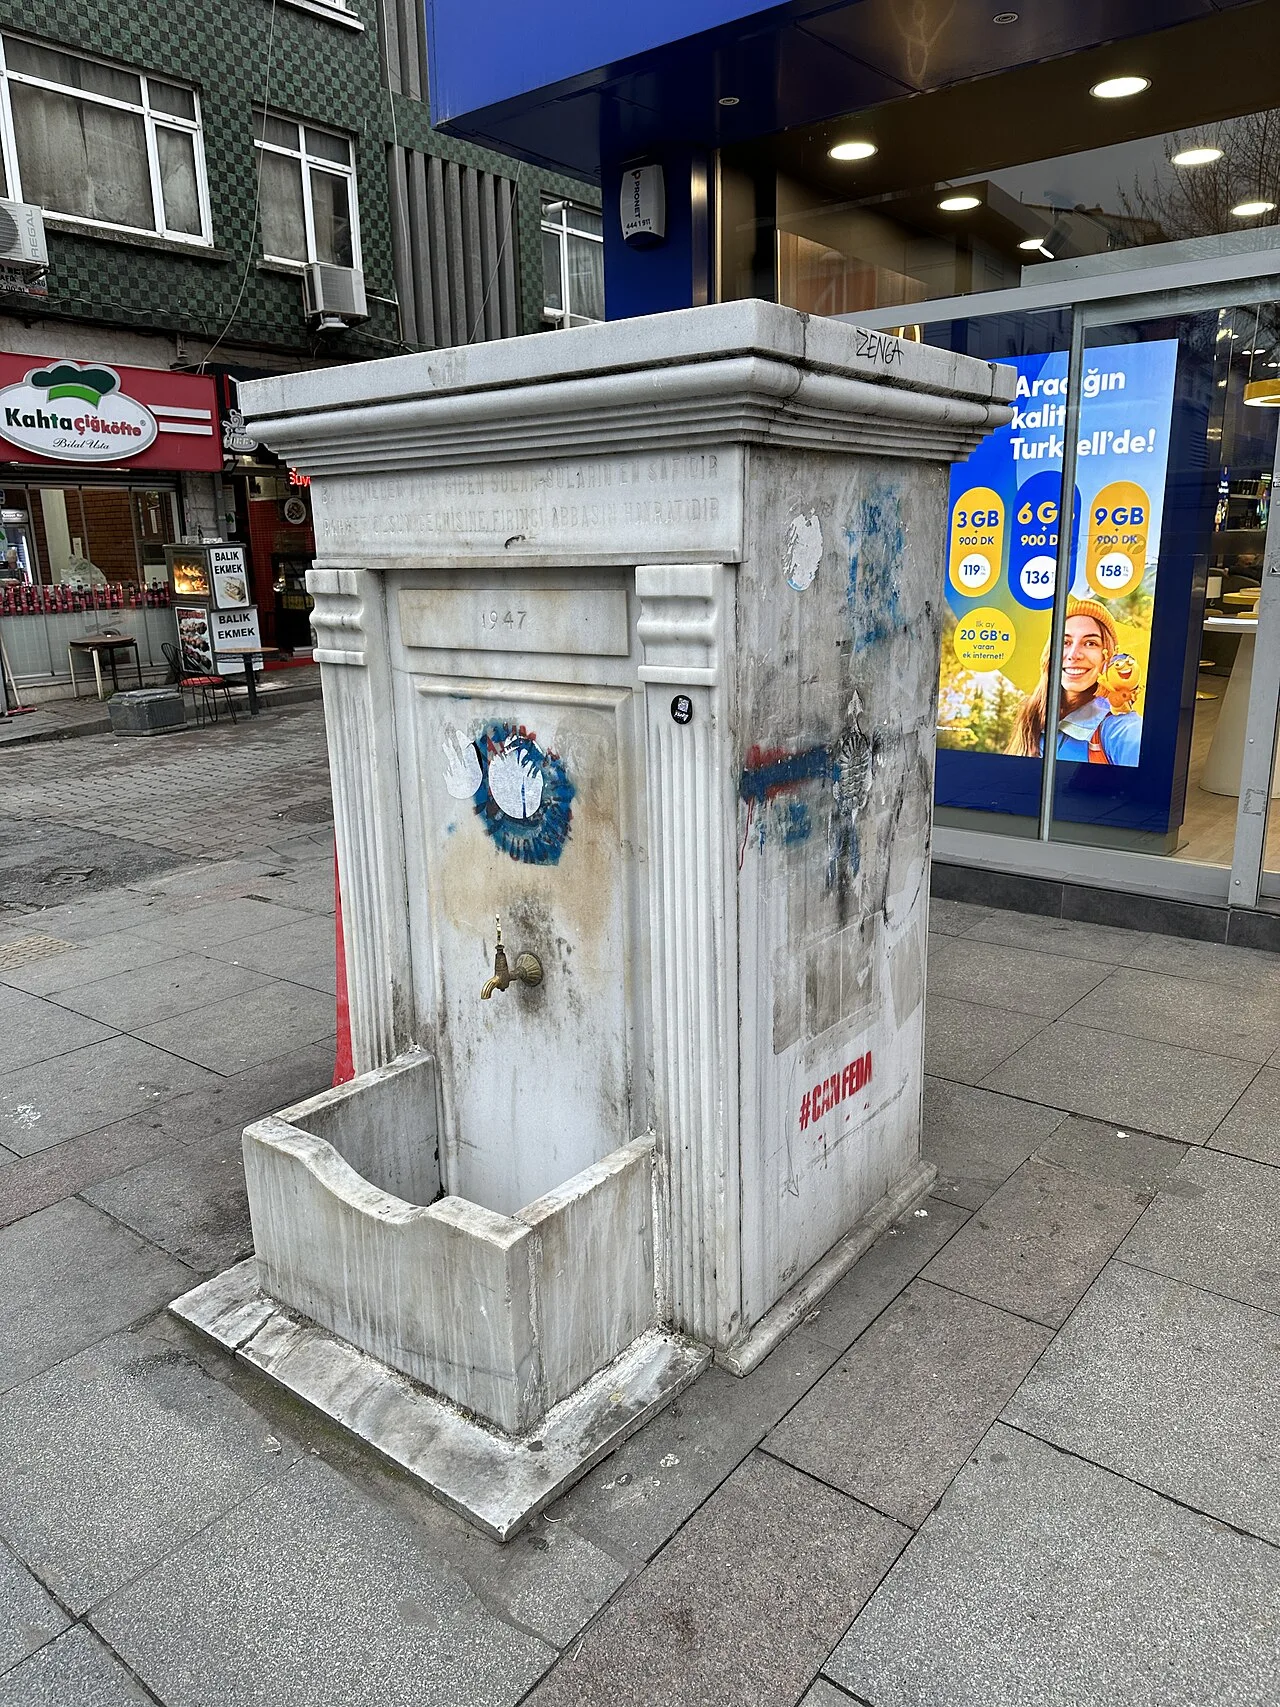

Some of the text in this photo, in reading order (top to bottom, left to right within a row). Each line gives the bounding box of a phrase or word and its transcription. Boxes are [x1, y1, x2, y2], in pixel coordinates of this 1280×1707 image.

[633, 181, 641, 218] PRONET
[26, 209, 40, 258] REGAL
[1016, 367, 1126, 398] Arağın
[1011, 403, 1081, 430] kalit
[52, 438, 110, 450] Bilal Usta
[1010, 428, 1156, 460] Turkell'de!
[957, 510, 999, 528] 3 GB
[1017, 502, 1033, 525] 6
[1095, 507, 1144, 526] 9 GB
[959, 536, 994, 546] 900 DK
[1021, 534, 1046, 546] 900
[1097, 535, 1138, 545] 900 DK
[215, 551, 239, 561] BALIK
[214, 564, 243, 574] EKMEK
[963, 565, 980, 575] 119
[1100, 565, 1122, 577] 158
[1025, 571, 1050, 584] 136
[218, 613, 251, 624] BALIK
[482, 610, 527, 630] 1947
[218, 627, 255, 639] EKMEK
[960, 629, 976, 641] 20
